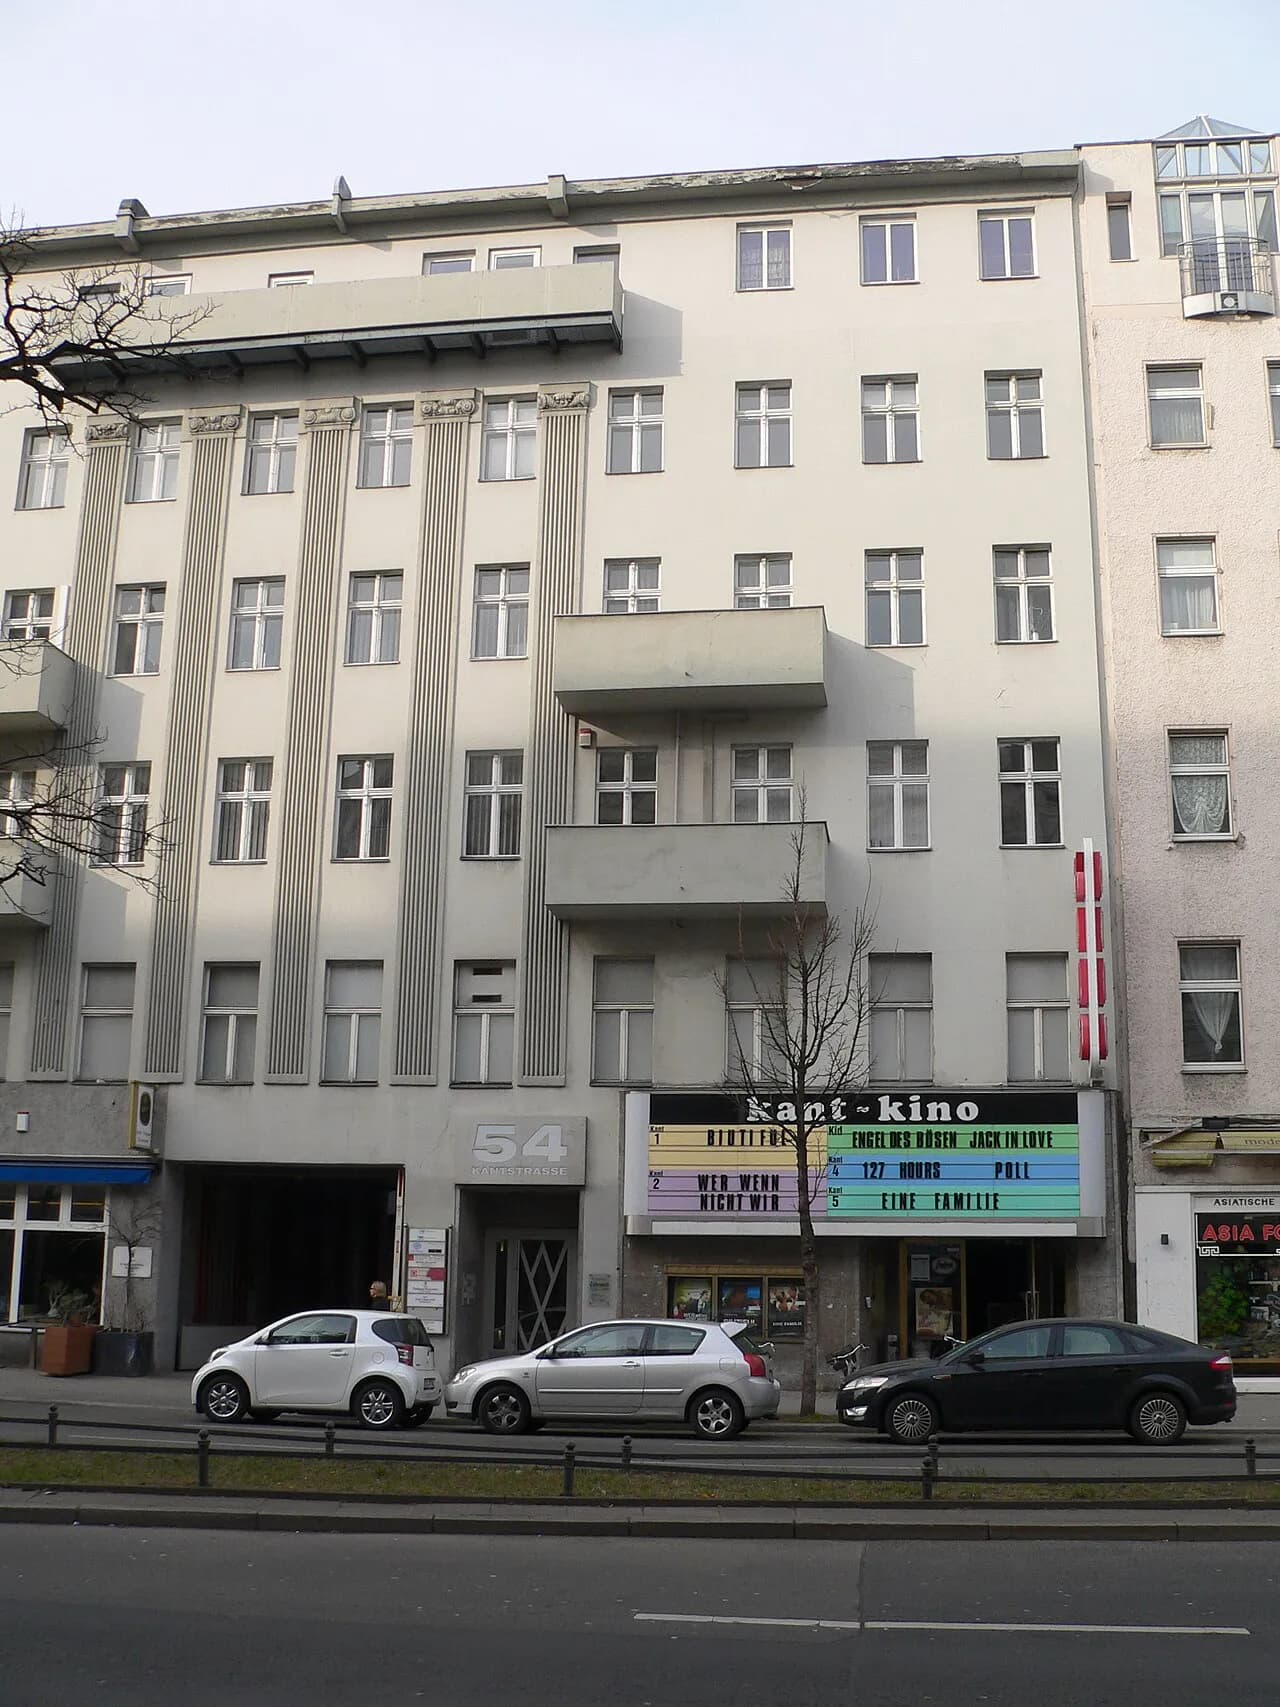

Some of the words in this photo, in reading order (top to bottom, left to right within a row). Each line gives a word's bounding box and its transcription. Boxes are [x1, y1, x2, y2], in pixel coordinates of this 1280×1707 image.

[654, 1133, 660, 1145] 1
[828, 1126, 843, 1135] Kid
[852, 1131, 887, 1149] ENGEL
[889, 1131, 911, 1149] DES
[916, 1129, 957, 1149] BÖSEN
[471, 1123, 568, 1163] 54
[969, 1131, 1001, 1149] JACK
[1005, 1131, 1019, 1149] IN
[1022, 1131, 1053, 1149] LOVE
[471, 1166, 568, 1176] KANTSTRASSE
[831, 1165, 839, 1176] 4
[862, 1161, 885, 1179] 127
[900, 1161, 941, 1179] HOURS
[995, 1161, 1030, 1179] POLL
[653, 1178, 660, 1190] 2
[698, 1174, 729, 1192] WER
[739, 1174, 780, 1192] WENN
[700, 1193, 743, 1211] NICHT
[749, 1193, 780, 1211] WIR
[832, 1195, 839, 1207] 5
[881, 1192, 916, 1210] EINE
[934, 1192, 1000, 1210] FAMILIE
[1214, 1198, 1275, 1206] ASIATISCHE
[1202, 1224, 1255, 1241] ASIA
